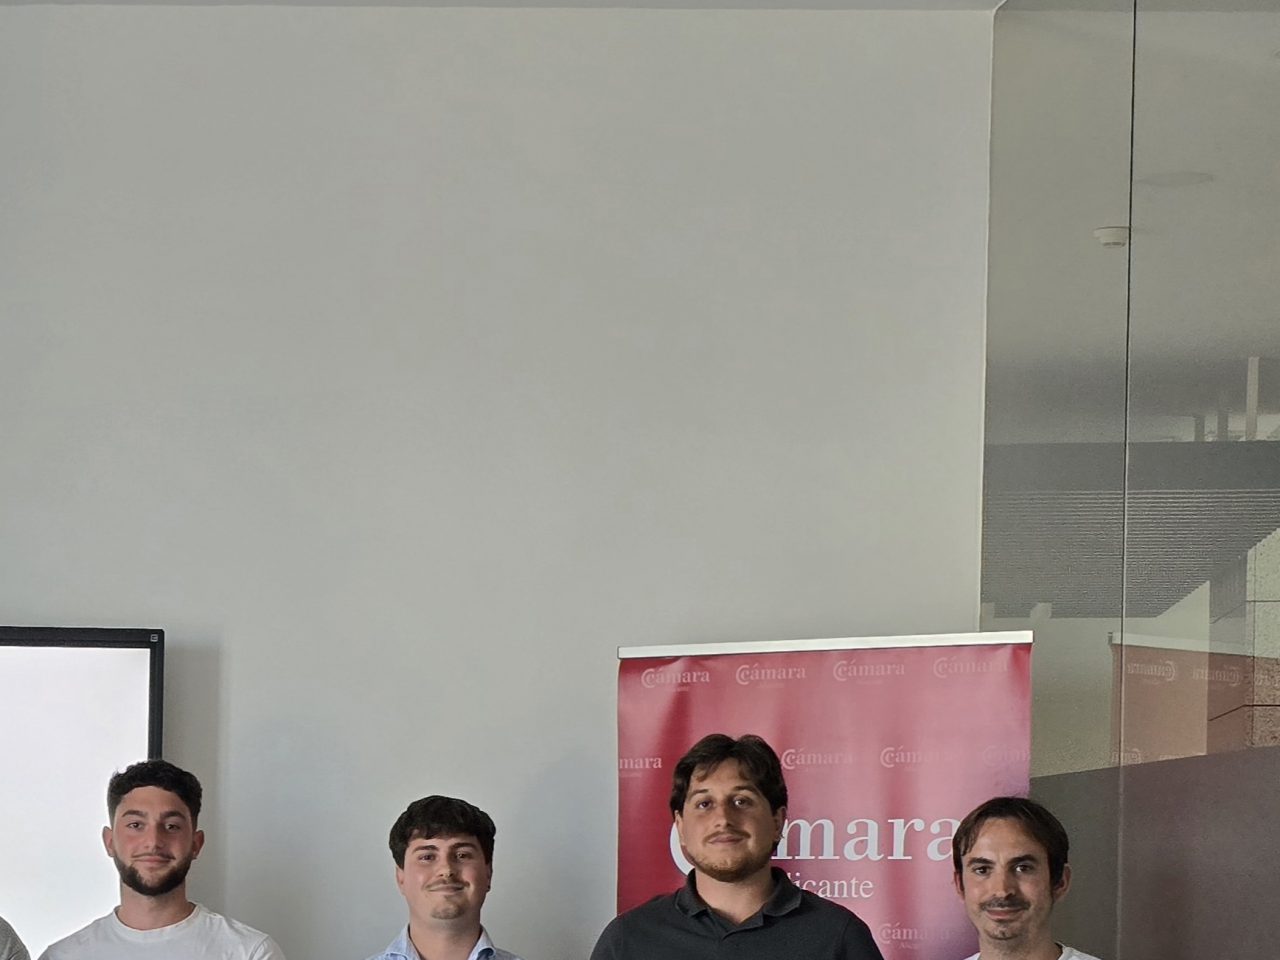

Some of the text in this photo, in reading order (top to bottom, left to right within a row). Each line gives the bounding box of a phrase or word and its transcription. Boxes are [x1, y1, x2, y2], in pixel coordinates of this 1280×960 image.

[641, 667, 710, 688] Cámara
[736, 664, 806, 685] Cámara
[833, 658, 905, 681] Cámara
[619, 757, 663, 769] mara
